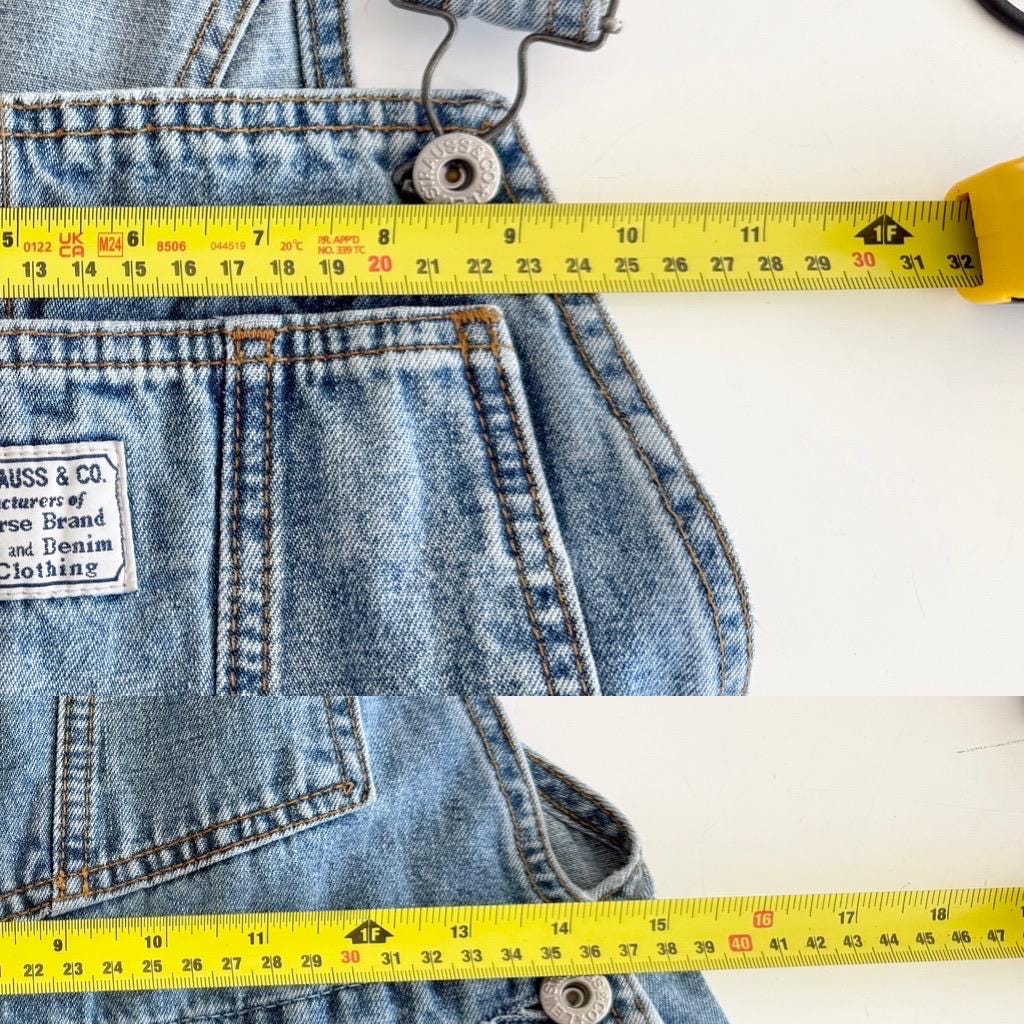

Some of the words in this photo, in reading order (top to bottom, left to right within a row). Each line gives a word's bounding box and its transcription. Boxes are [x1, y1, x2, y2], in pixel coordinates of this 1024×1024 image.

[3, 232, 13, 247] 5
[127, 231, 139, 246] 6
[253, 231, 264, 245] 7
[378, 230, 389, 244] 8
[504, 229, 515, 244] 9
[617, 228, 637, 242] 10
[741, 227, 759, 242] 11
[24, 242, 51, 252] 0122
[59, 233, 83, 244] UK
[100, 236, 121, 252] M24
[157, 241, 186, 252] 8506
[211, 240, 245, 251] 044519
[59, 246, 84, 258] CA
[337, 246, 352, 255] 339
[354, 245, 365, 254] TC
[22, 262, 47, 277] 13
[72, 262, 96, 276] 14
[122, 262, 146, 276] 15
[172, 261, 196, 276] 16
[221, 261, 244, 276] 17
[270, 261, 294, 275] 18
[319, 260, 344, 275] 19
[368, 257, 392, 272] 20
[417, 260, 439, 274] 21
[467, 259, 492, 274] 22
[517, 259, 541, 273] 23
[566, 258, 591, 273] 24
[615, 257, 639, 273] 25
[663, 257, 687, 272] 26
[711, 257, 734, 272] 27
[759, 256, 783, 271] 28
[805, 256, 830, 271] 29
[852, 252, 876, 267] 30
[900, 255, 923, 270] 31
[947, 254, 974, 269] 32
[56, 466, 69, 486] &
[76, 464, 106, 483] CO.
[68, 491, 86, 509] of
[42, 507, 105, 530] Brand
[9, 542, 34, 556] and
[42, 534, 112, 555] Denim
[53, 939, 63, 952] 9
[145, 936, 162, 948] 10
[247, 932, 264, 945] 11
[451, 926, 468, 938] 13
[551, 922, 569, 935] 14
[649, 919, 666, 932] 15
[755, 913, 771, 925] 16
[839, 912, 854, 924] 17
[930, 908, 946, 920] 18
[341, 951, 360, 963] 30
[731, 937, 750, 950] 40
[770, 938, 788, 950] 41
[807, 937, 826, 949] 42
[844, 935, 863, 947] 43
[880, 934, 899, 946] 44
[916, 933, 934, 944] 45
[952, 931, 971, 943] 46
[988, 930, 1005, 942] 47
